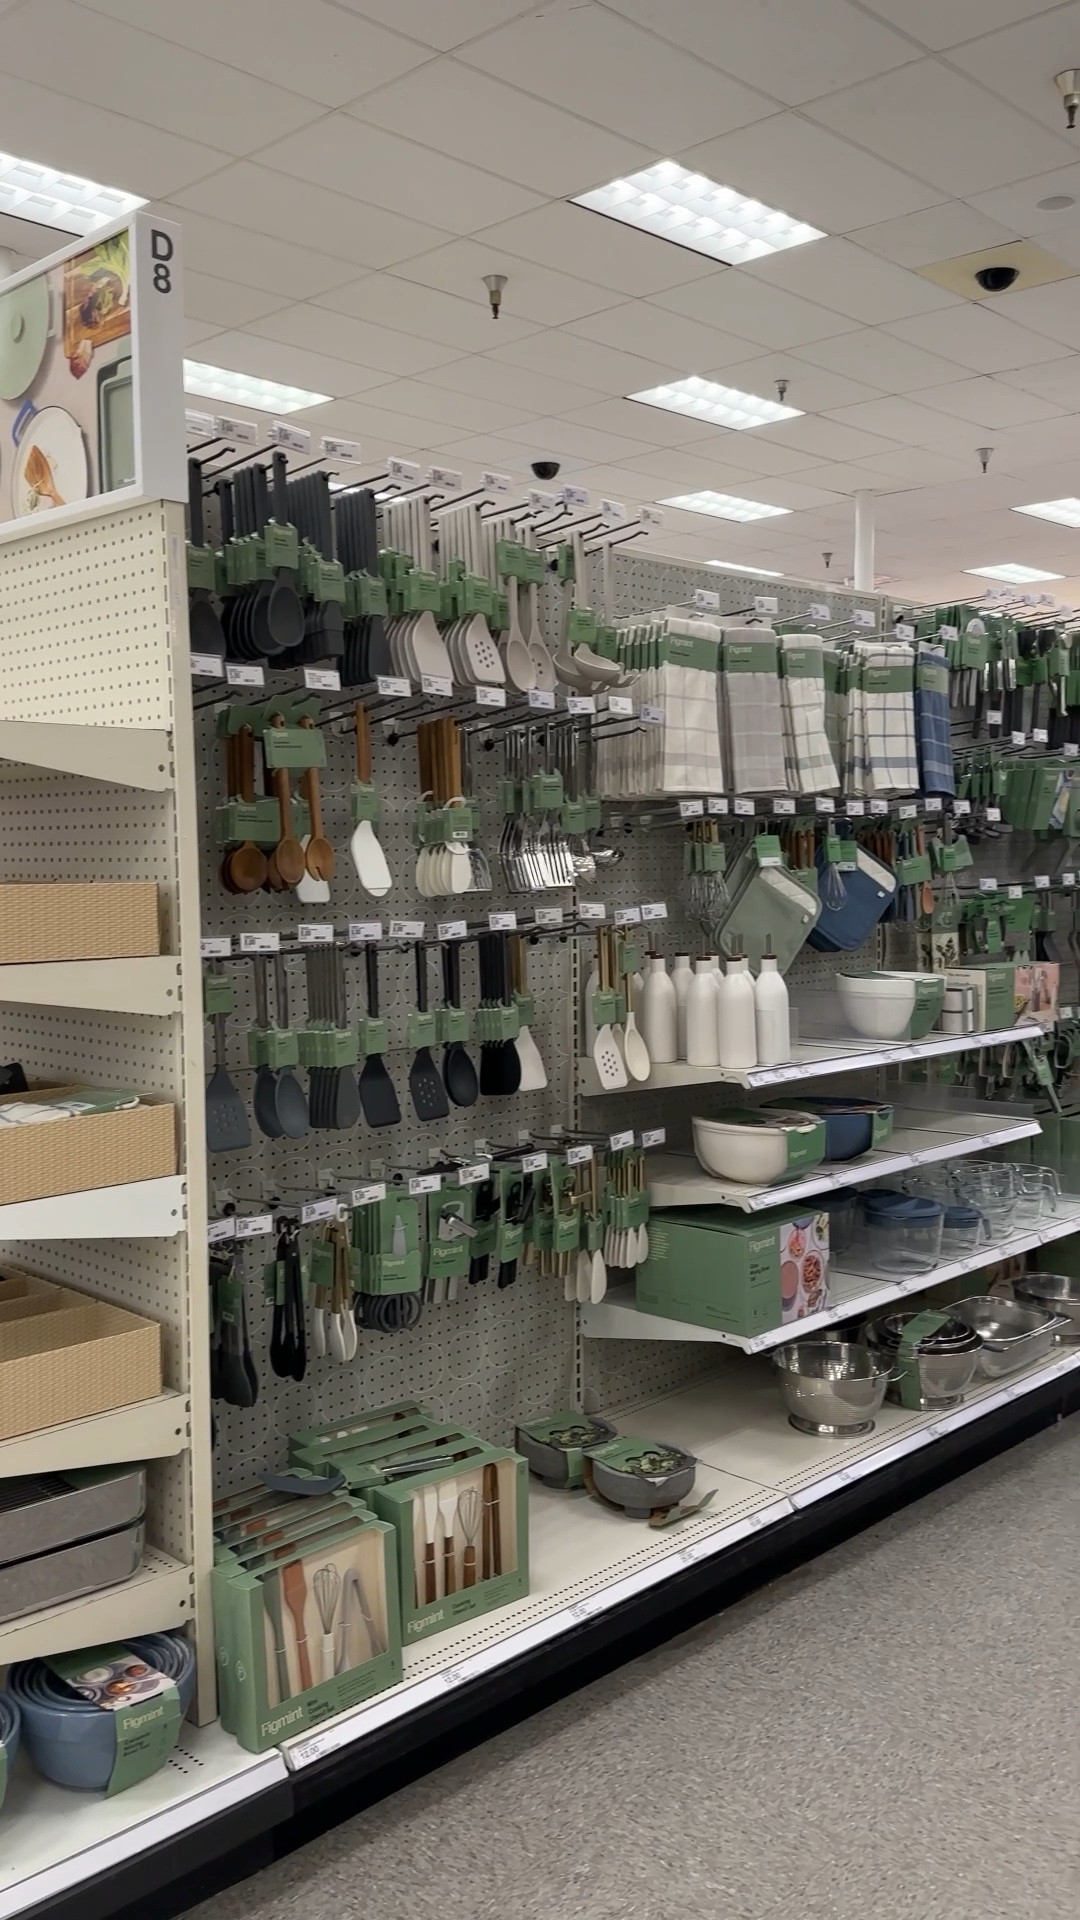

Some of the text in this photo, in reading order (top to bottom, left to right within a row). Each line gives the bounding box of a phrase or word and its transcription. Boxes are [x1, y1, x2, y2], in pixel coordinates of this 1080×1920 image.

[151, 229, 173, 261] D
[153, 263, 171, 293] 8
[407, 1608, 444, 1634] Figmint
[123, 1705, 165, 1730] Figmint
[261, 1705, 304, 1737] Figmint
